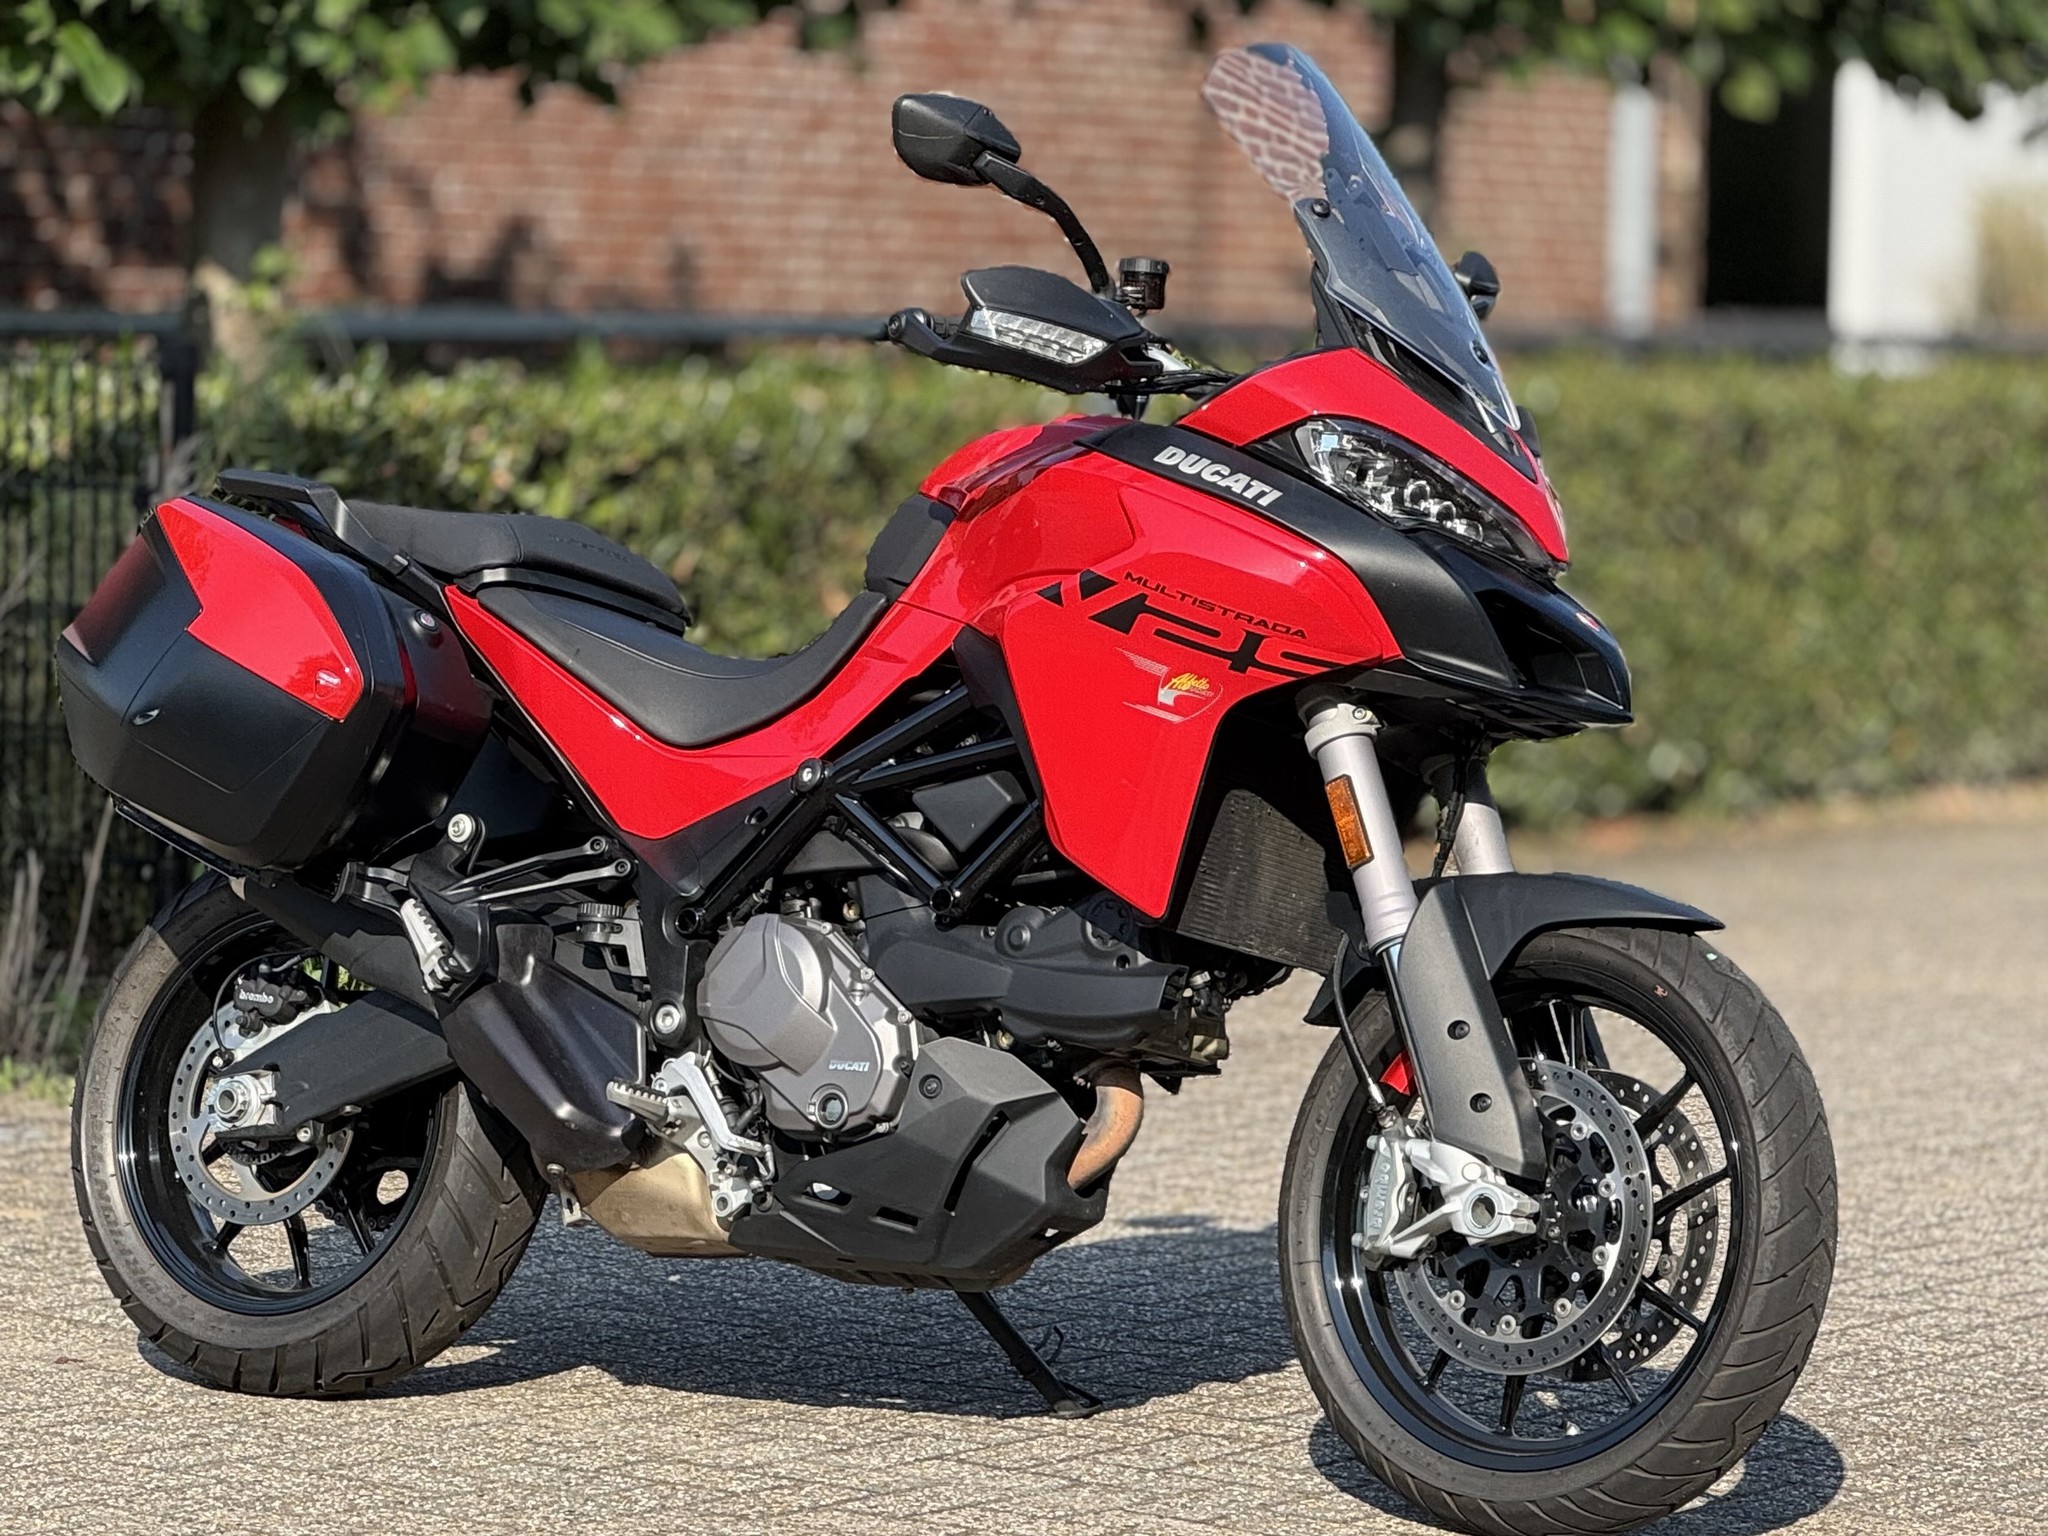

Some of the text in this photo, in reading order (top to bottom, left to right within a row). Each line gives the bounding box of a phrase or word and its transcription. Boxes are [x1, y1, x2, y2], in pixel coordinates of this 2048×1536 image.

[1153, 446, 1283, 507] DUCATI
[1123, 571, 1309, 640] MULTISTRADA
[239, 989, 274, 1004] brembo
[828, 1059, 870, 1072] DUCATI
[1370, 1162, 1391, 1230] brembo
